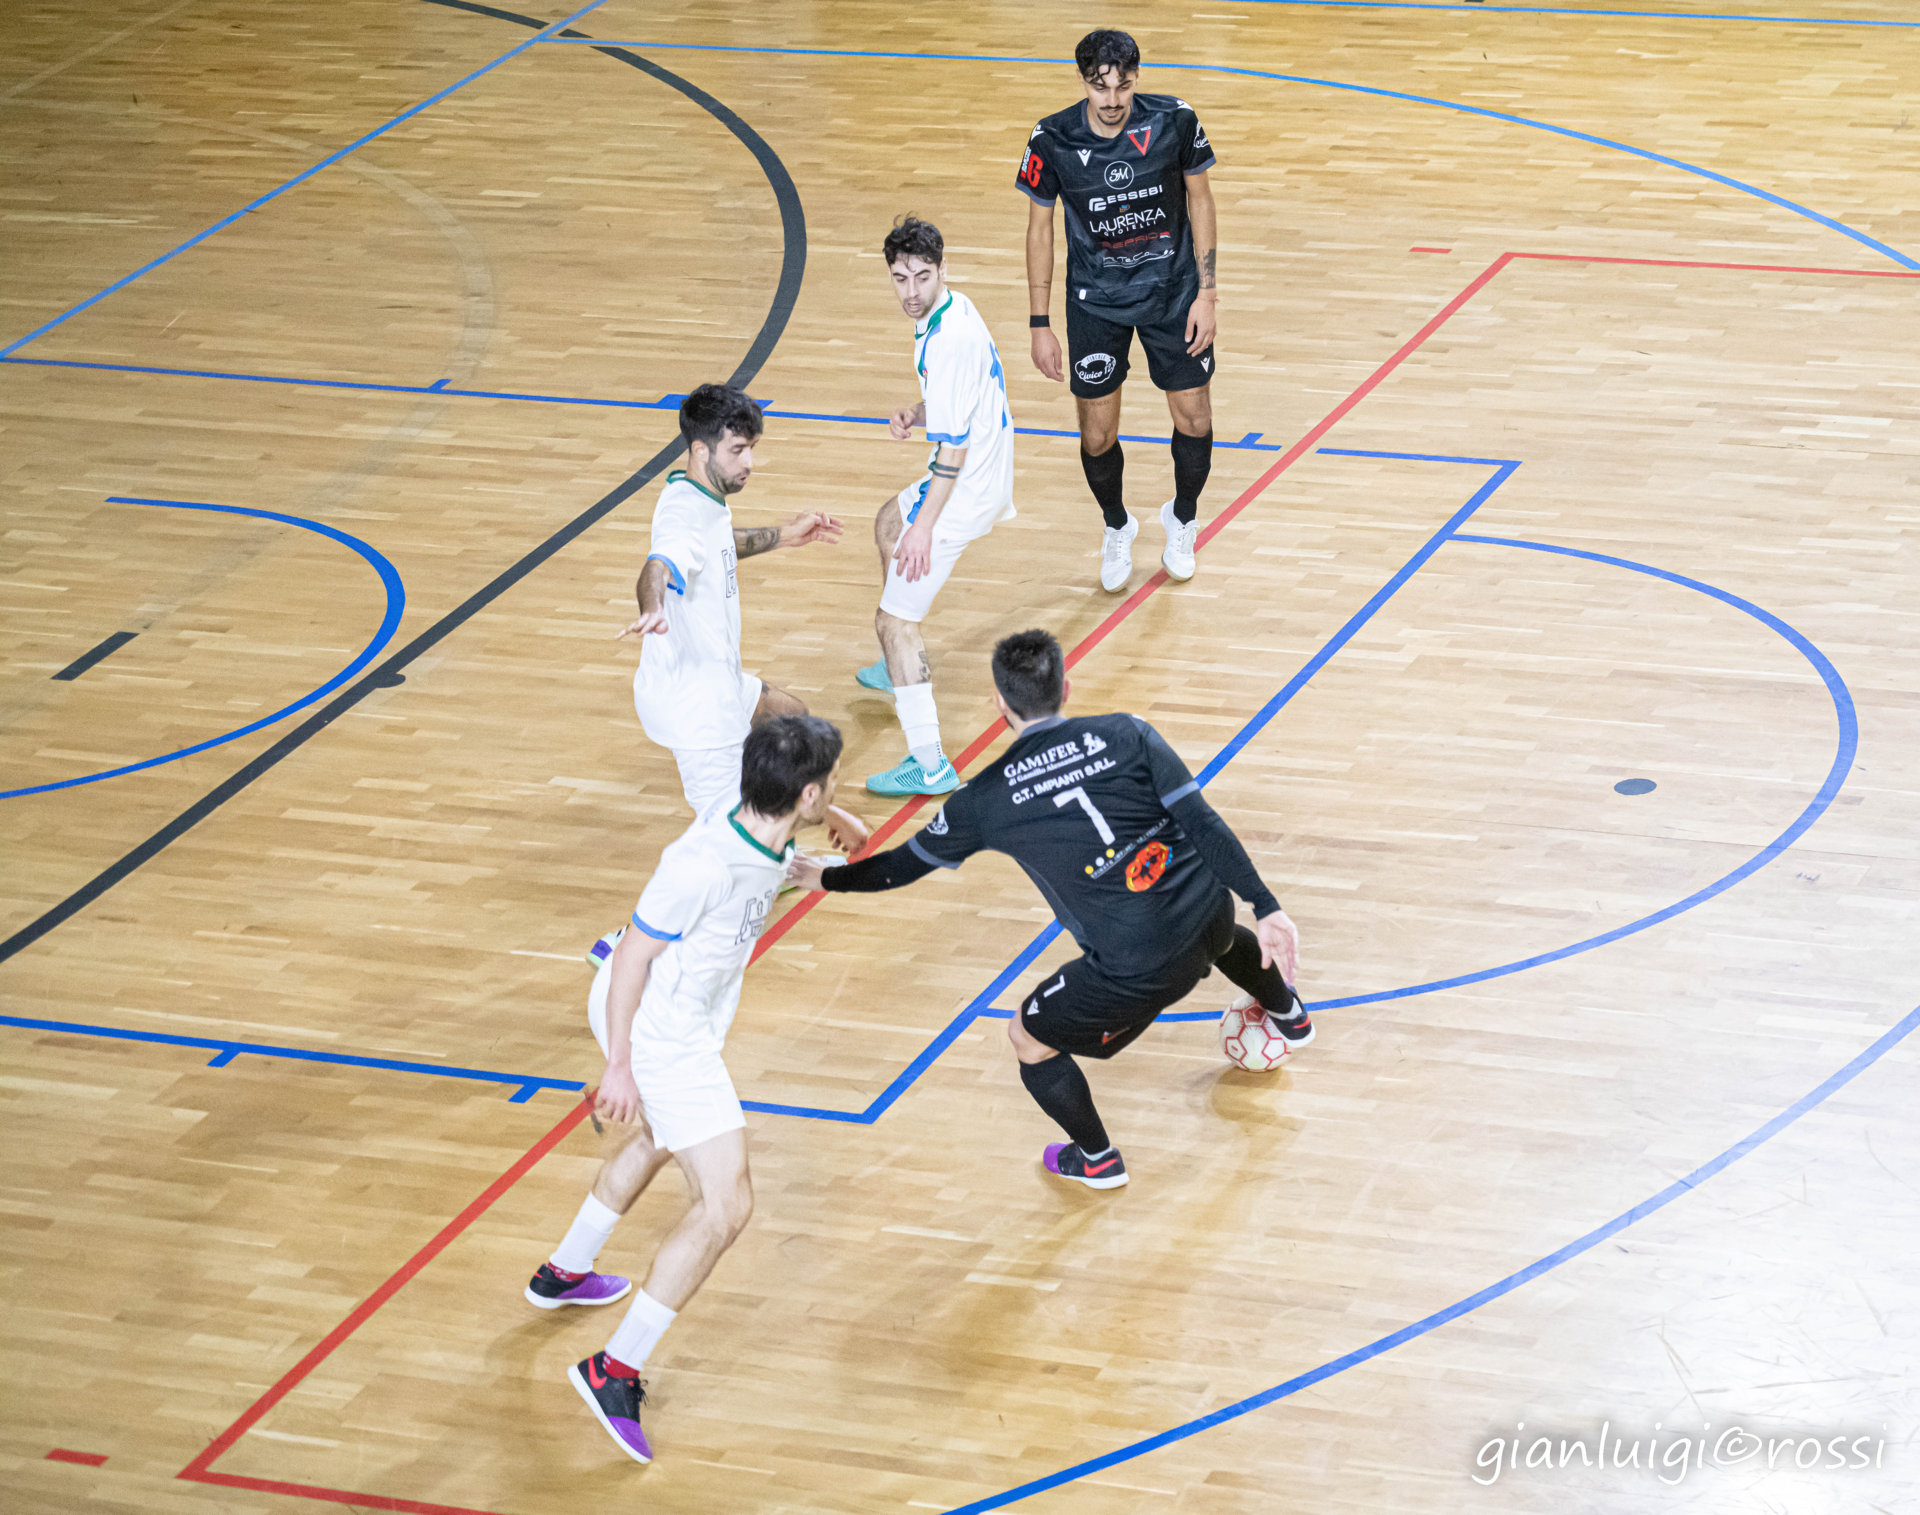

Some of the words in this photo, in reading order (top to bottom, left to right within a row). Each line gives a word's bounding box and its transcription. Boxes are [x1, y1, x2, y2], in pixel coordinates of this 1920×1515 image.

[1106, 184, 1163, 204] ESSEBI
[1090, 207, 1166, 233] LAURENZA
[1103, 221, 1157, 238] GIOIELLI
[1079, 370, 1103, 380] Civico
[1003, 741, 1080, 778] GAMIFER
[1012, 787, 1034, 805] C.T.
[1033, 769, 1085, 795] IMPIANTI
[1052, 786, 1116, 846] 7
